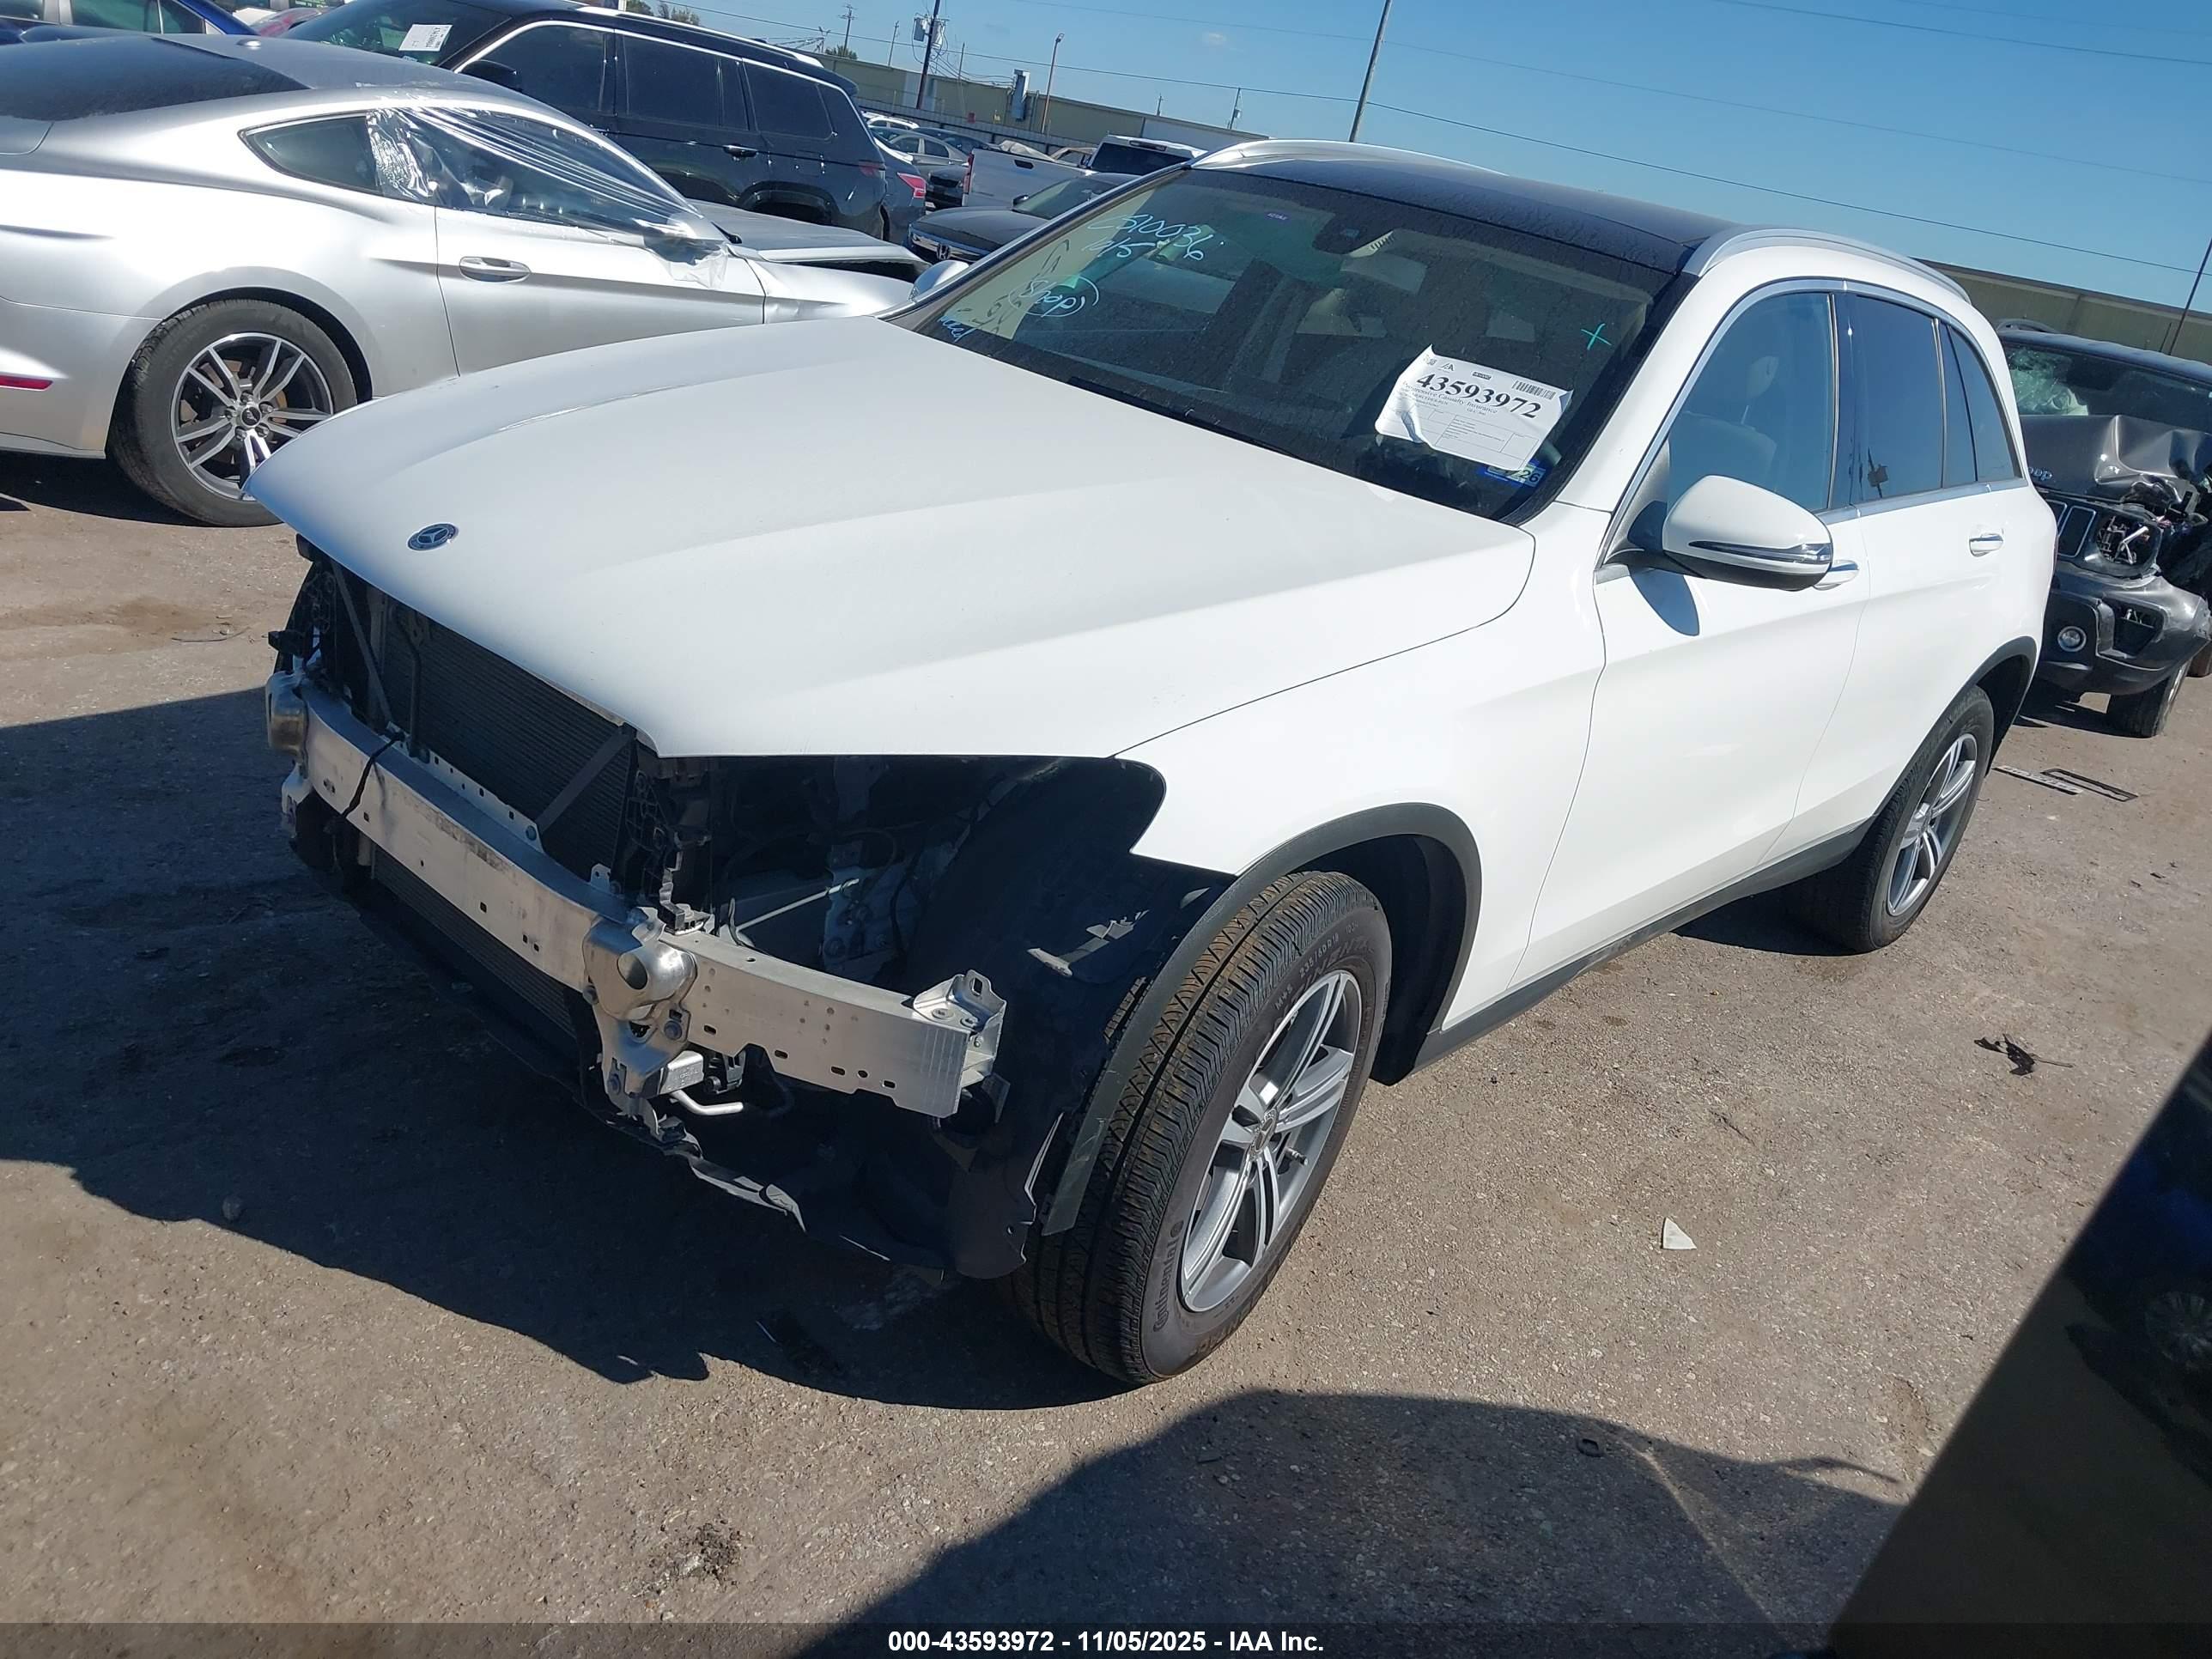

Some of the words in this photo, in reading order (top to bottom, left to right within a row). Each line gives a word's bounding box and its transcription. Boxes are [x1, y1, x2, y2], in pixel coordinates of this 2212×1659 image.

[1416, 373, 1542, 418] 43593972
[1466, 400, 1498, 414] Insurance
[1152, 1237, 1180, 1333] Continental
